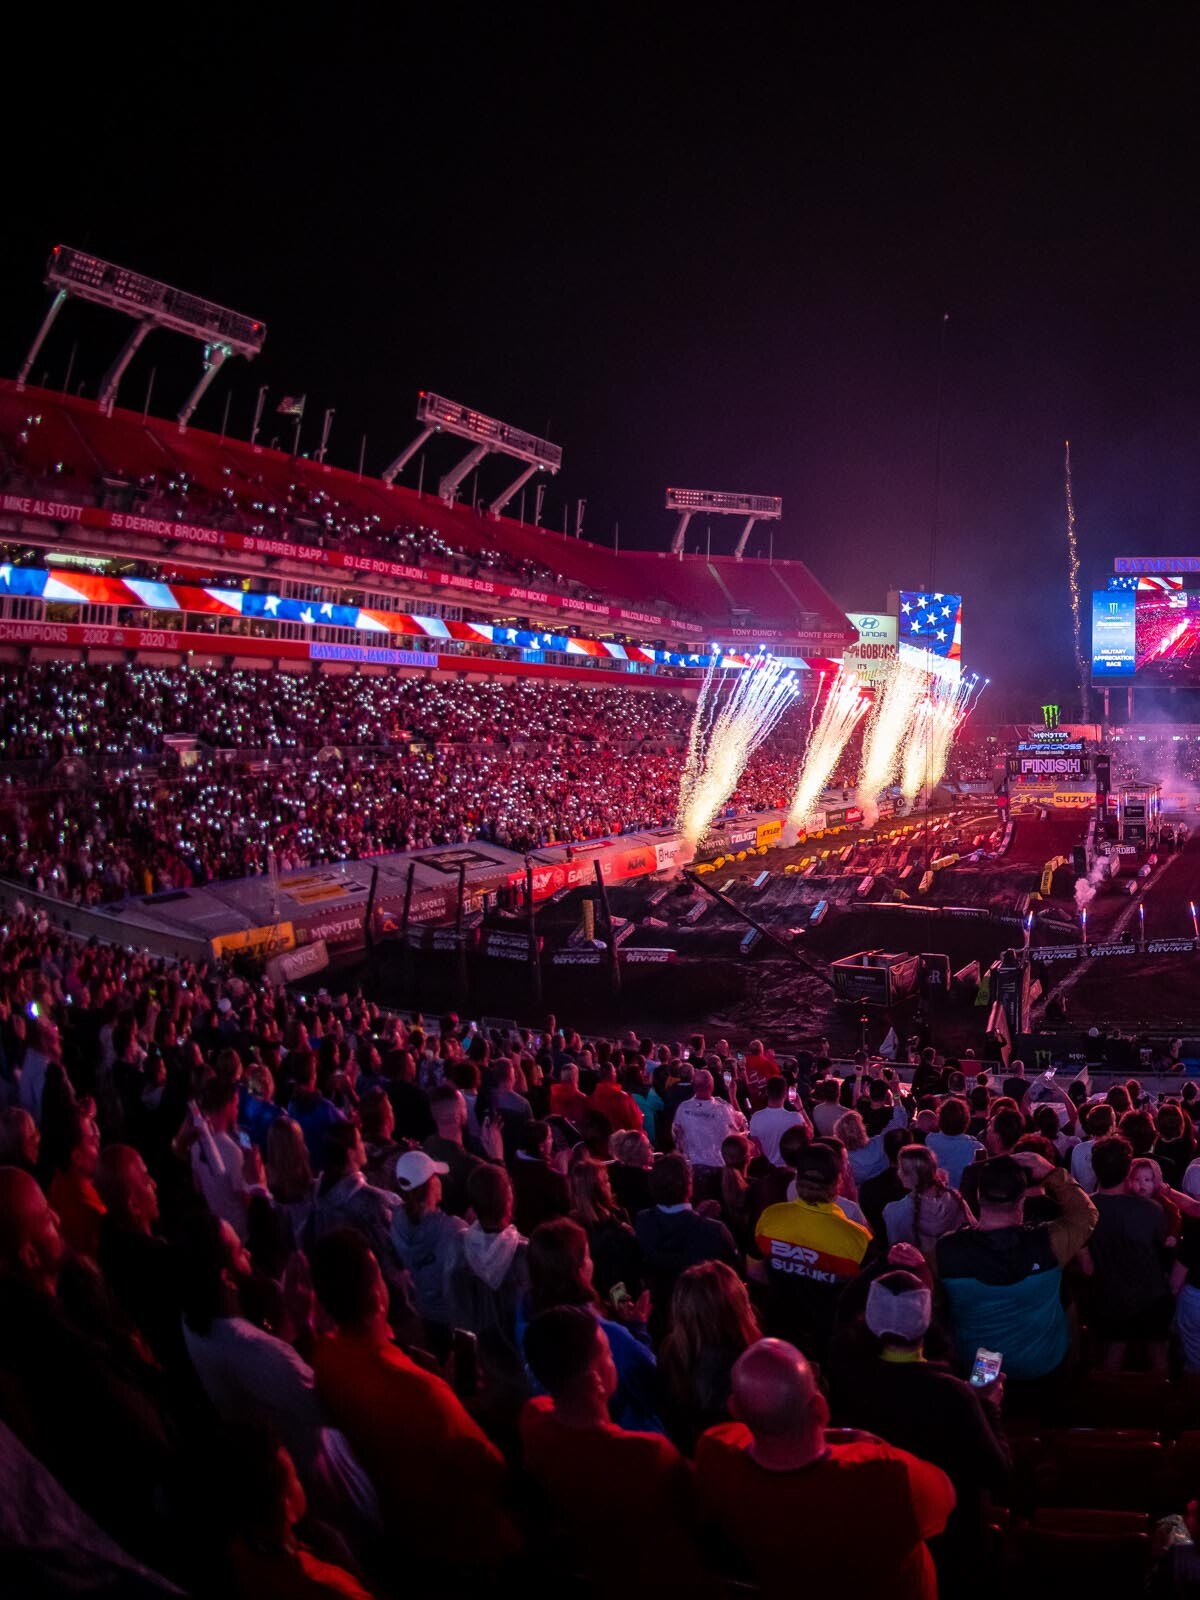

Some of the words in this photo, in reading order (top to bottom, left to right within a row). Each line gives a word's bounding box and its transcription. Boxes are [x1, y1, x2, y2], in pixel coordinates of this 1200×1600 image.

[3, 495, 31, 513] MIKE
[33, 502, 83, 521] ALSTOTT
[111, 513, 123, 527] 55
[125, 515, 172, 536] DERRICK
[174, 524, 219, 544] BROOKS
[243, 536, 255, 549] 99
[256, 539, 297, 557] WARREN
[298, 548, 322, 561] SAPP
[344, 554, 353, 567] 63
[355, 557, 371, 571] LEE
[373, 561, 390, 574] ROY
[391, 563, 423, 580] SELMON
[1116, 558, 1199, 572] RAYMOND
[474, 580, 494, 593] GILES
[510, 587, 527, 599] JOHN
[0, 624, 68, 642] CHAMPIONS
[83, 630, 110, 645] 2002
[140, 633, 166, 647] 2020
[732, 628, 751, 638] TONY
[752, 629, 777, 638] DUNGY
[797, 631, 822, 639] MONTE
[823, 632, 845, 640] KIFFIN
[861, 630, 888, 638] UNDAI
[1033, 731, 1069, 740] MONSTER
[1018, 743, 1083, 751] SUPERCROSS
[1021, 758, 1081, 774] FINISH
[731, 830, 758, 844] FALKEN
[310, 917, 362, 939] MONSTER
[770, 1239, 820, 1265] BAR
[770, 1257, 836, 1285] SUZUKI
